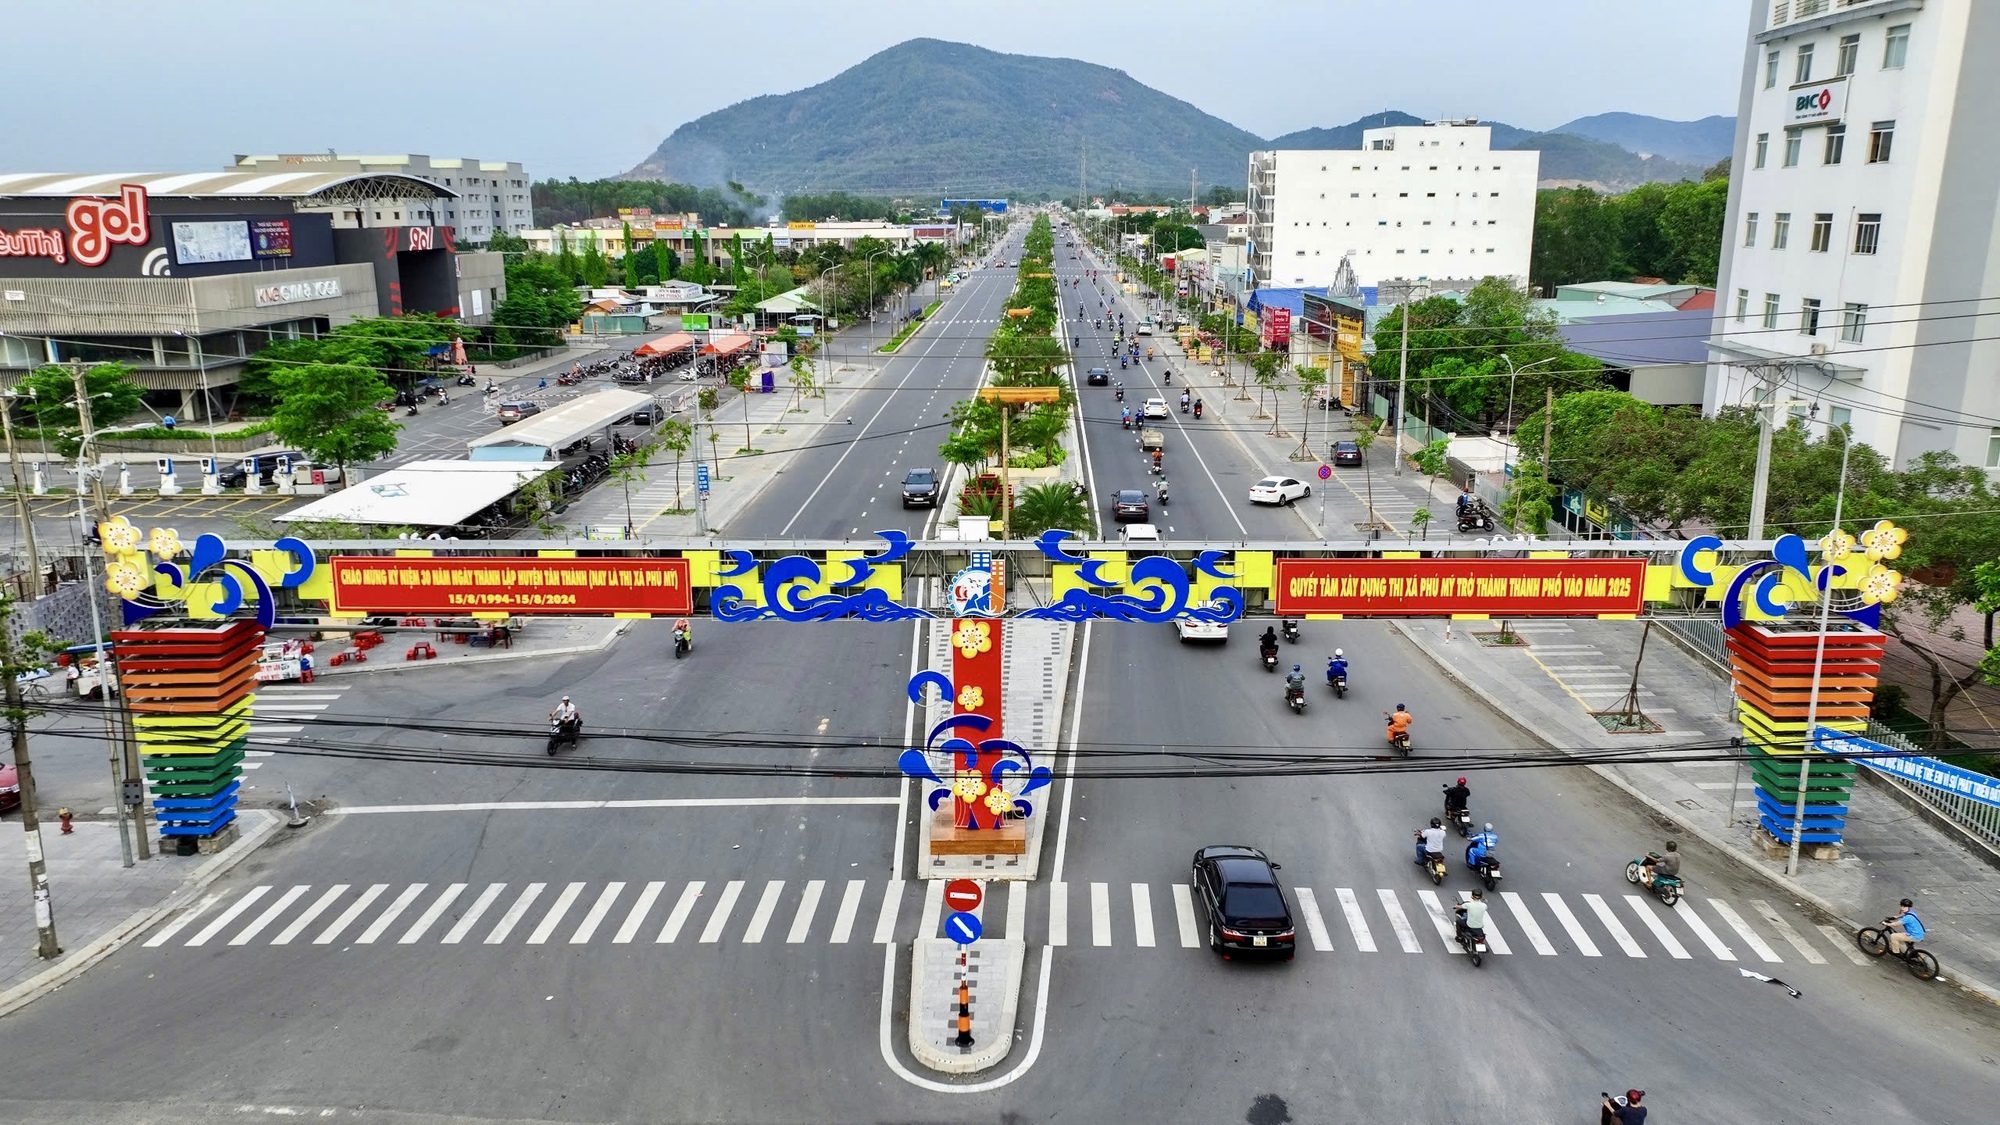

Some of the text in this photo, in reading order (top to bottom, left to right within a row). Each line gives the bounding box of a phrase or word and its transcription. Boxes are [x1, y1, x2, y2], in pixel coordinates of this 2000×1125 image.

[67, 184, 149, 266] go!
[313, 280, 340, 296] YOGA
[340, 565, 678, 590] CHÀO MỪNG KỶ NIỆM 30 NĂM NGÀY THÀNH LẬP HUYỆN TÂN THÀNH (NAY LÀ THỊ XÃ PHÚ MỸ)
[1289, 571, 1631, 602] QUYẾT TÂM XÂY DỰNG THỊ XÃ PHÚ MỸ TRỞ THÀNH THÀNH PHỐ VÀO NĂM 2025
[448, 593, 576, 605] 15/8/1994-15/8/2024
[1933, 770, 1944, 784] EM
[1957, 777, 1974, 794] PHÁT
[1973, 778, 1991, 799] TRIỂN
